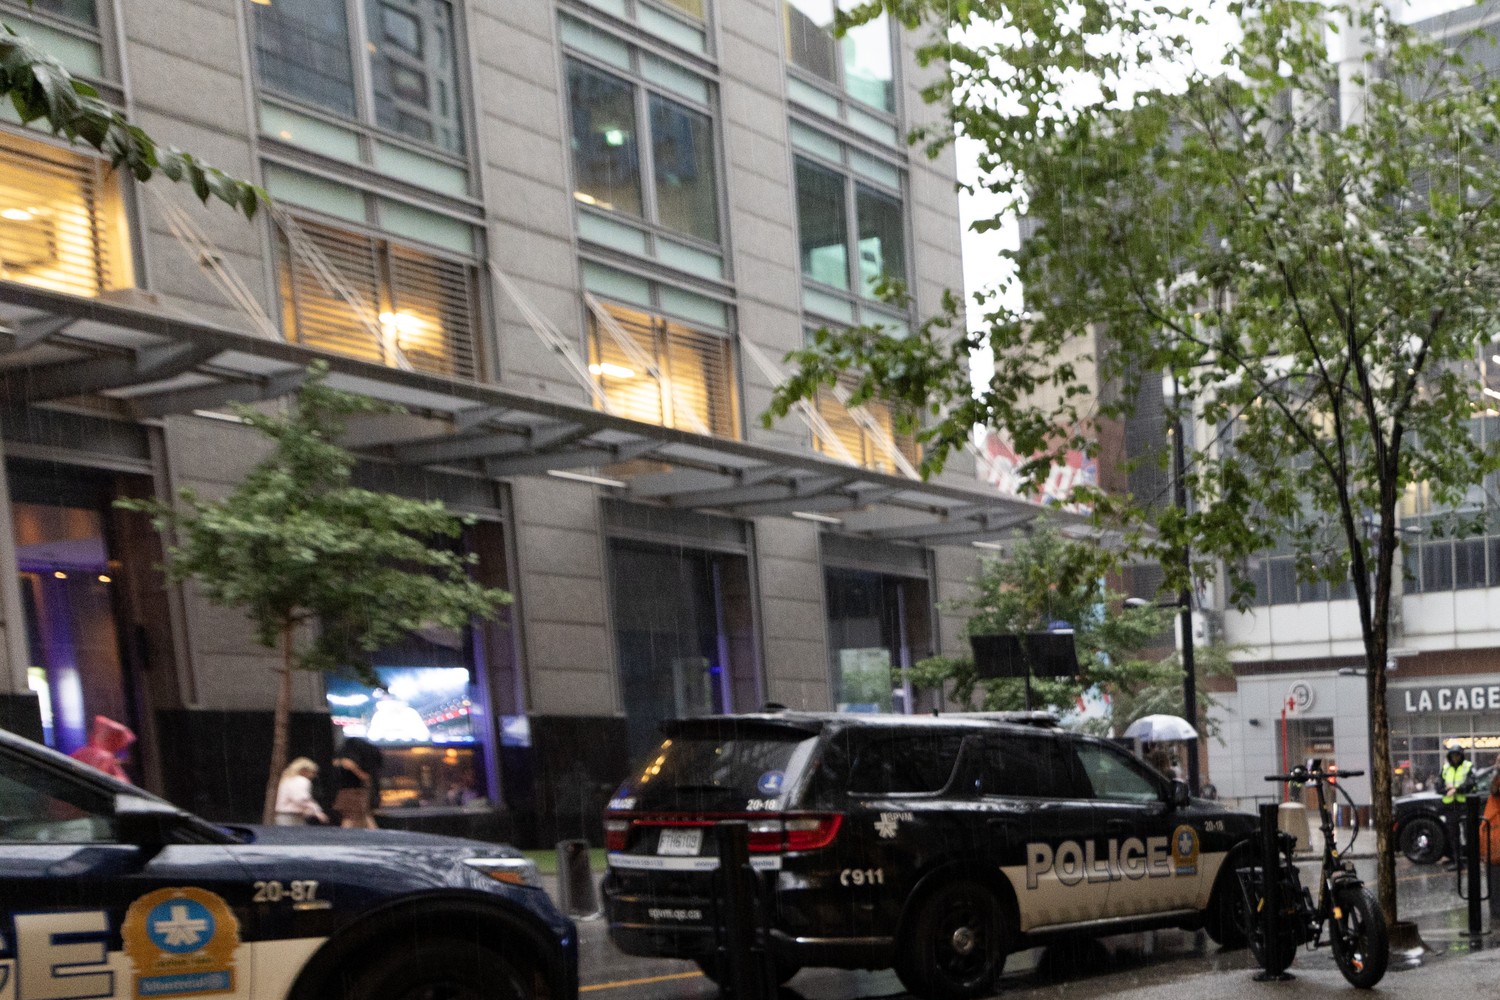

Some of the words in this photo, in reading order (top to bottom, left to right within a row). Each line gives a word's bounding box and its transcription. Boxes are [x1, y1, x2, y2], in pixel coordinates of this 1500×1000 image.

[1405, 689, 1432, 712] LA
[1437, 686, 1500, 711] CAGE
[1026, 836, 1171, 890] POLICE
[851, 868, 884, 886] 911
[253, 879, 318, 902] 20-87
